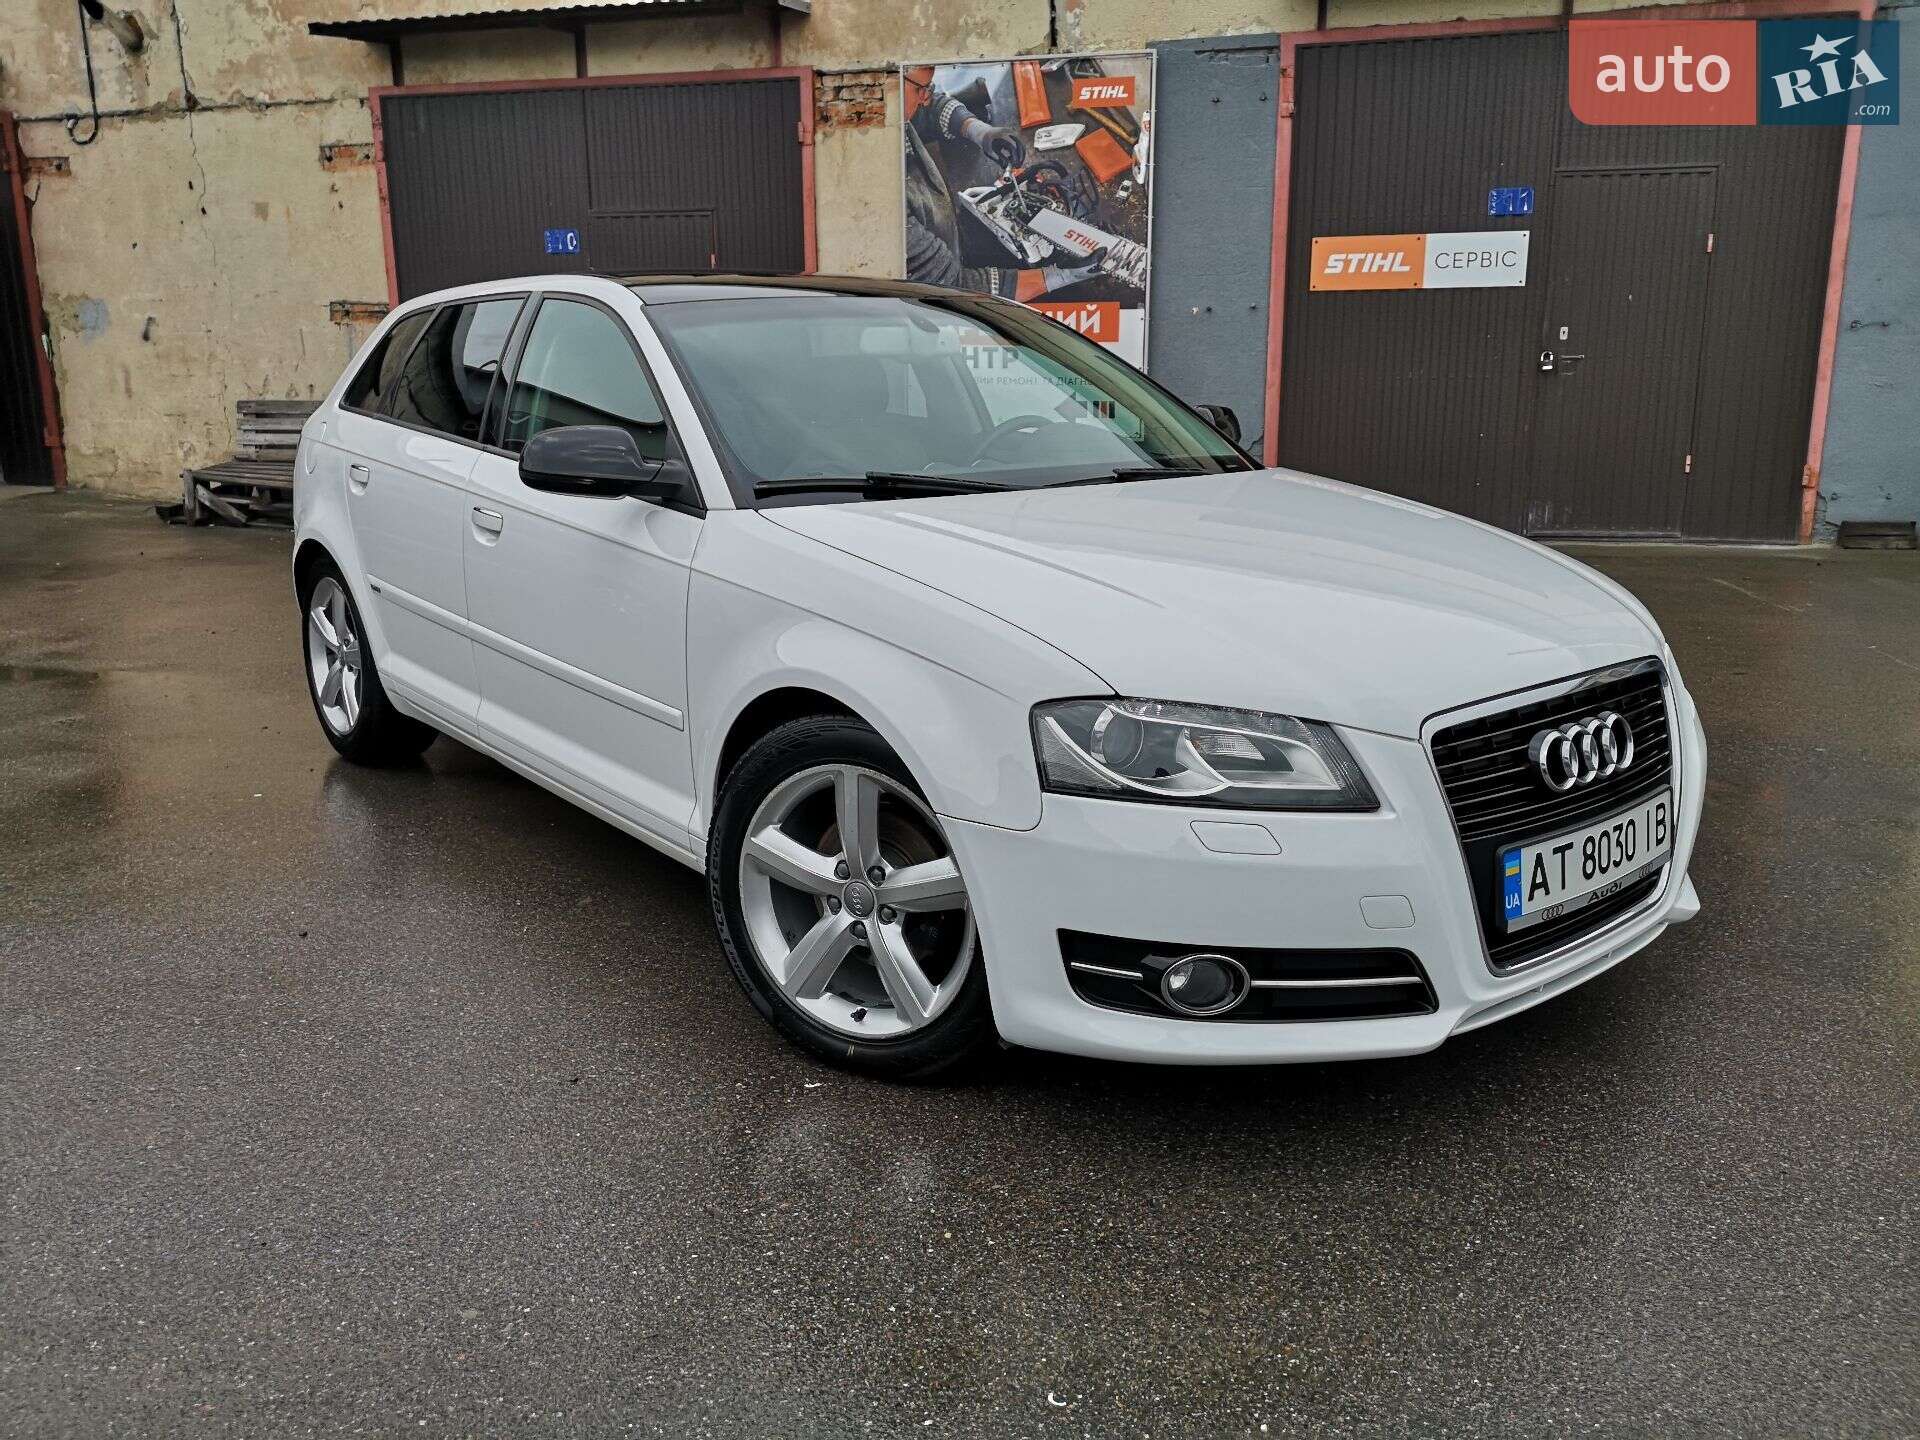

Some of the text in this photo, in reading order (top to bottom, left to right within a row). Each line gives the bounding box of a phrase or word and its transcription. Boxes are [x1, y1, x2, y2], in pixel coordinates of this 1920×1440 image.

[1079, 85, 1128, 99] STIHL
[1323, 251, 1411, 274] STIHL
[1434, 250, 1518, 269] СЕРВІС
[1045, 303, 1102, 334] ИЙ
[1527, 802, 1667, 902] AT 8030 IB
[1505, 892, 1521, 910] UA
[1587, 881, 1623, 904] Audi
